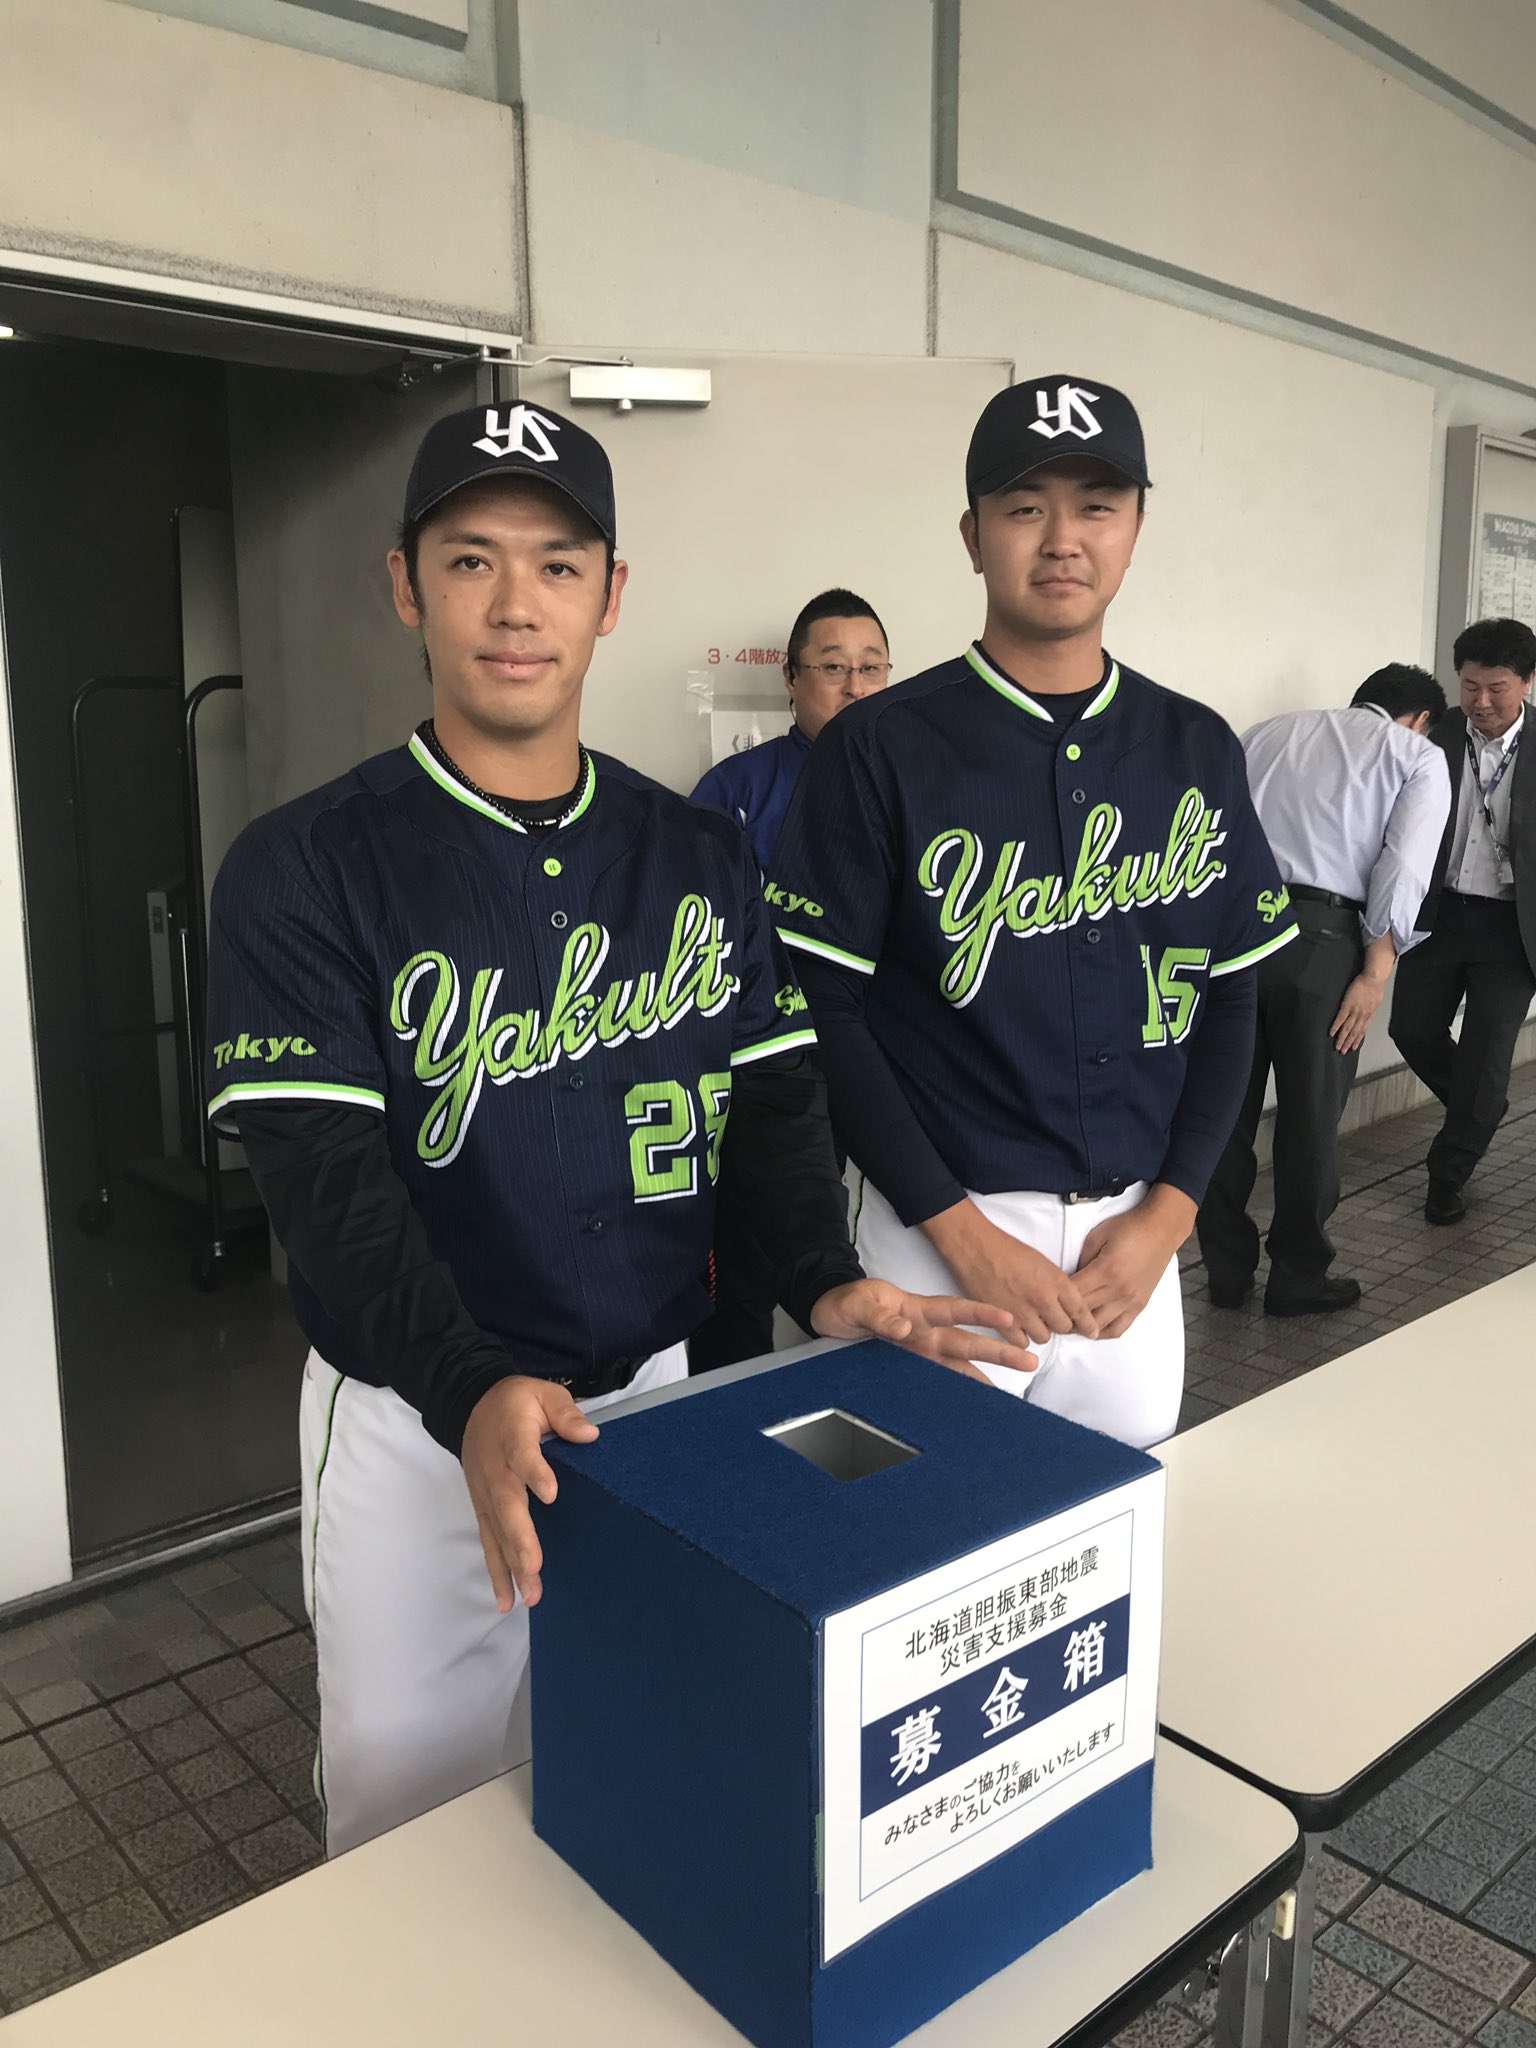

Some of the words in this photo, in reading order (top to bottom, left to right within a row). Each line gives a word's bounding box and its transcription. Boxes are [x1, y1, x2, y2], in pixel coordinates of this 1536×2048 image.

[763, 881, 824, 917] kyo
[917, 787, 1227, 1009] Yakult
[390, 893, 740, 1168] Yakult
[1139, 944, 1211, 1049] 15
[905, 1546, 1099, 1659] 北海道胆振東部地震
[940, 1592, 1068, 1676] 災害支援募金
[890, 1619, 1108, 1787] 募金箱
[884, 1760, 1021, 1846] みなさまのご協力を
[950, 1722, 1115, 1833] よろしくお願いいたします
